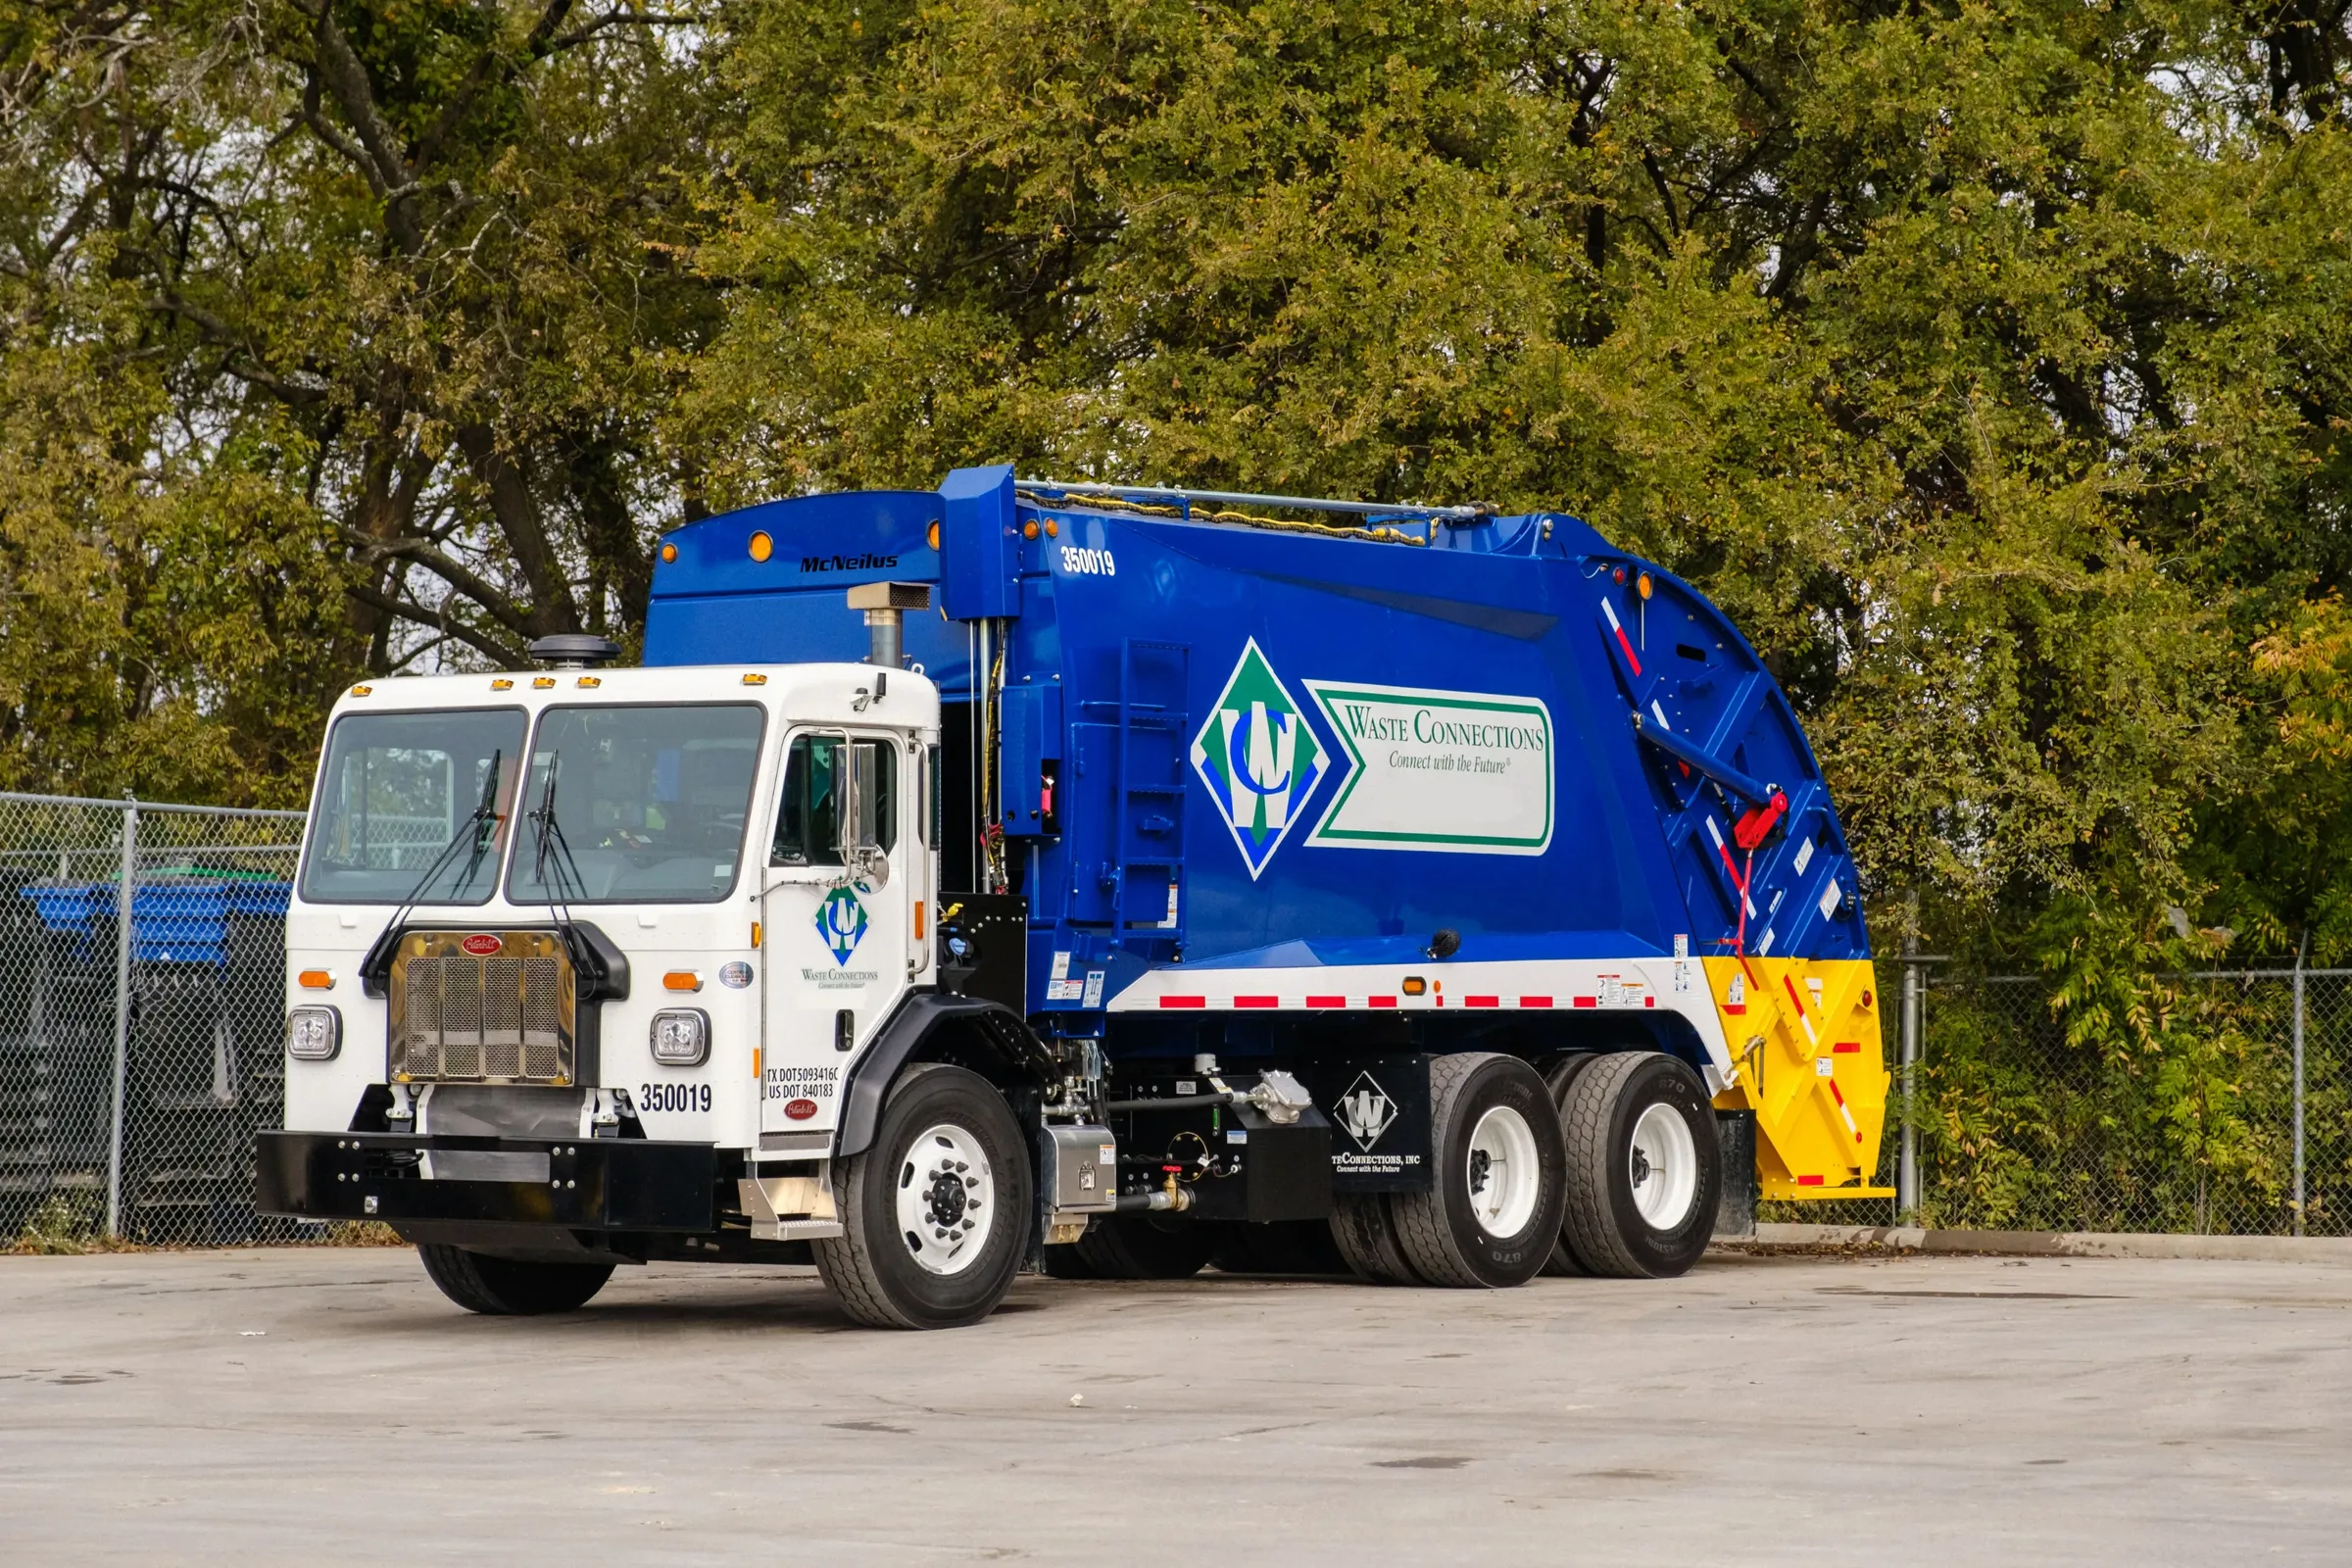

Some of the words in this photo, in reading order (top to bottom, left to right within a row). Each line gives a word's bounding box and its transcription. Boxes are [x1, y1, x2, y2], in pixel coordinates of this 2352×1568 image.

[800, 554, 899, 573] McNeilus
[1060, 546, 1115, 576] 350019
[1345, 705, 1408, 742] WASTE
[1414, 709, 1544, 752] CONNECTIONS
[1389, 750, 1431, 769] Connect
[1433, 754, 1454, 771] with
[1456, 754, 1472, 772] the
[802, 968, 827, 981] WASTE
[828, 968, 878, 981] CONNECTIONS
[767, 1068, 777, 1083] TX
[641, 1084, 711, 1112] 350019
[769, 1085, 781, 1099] US
[783, 1084, 800, 1099] DOT
[802, 1083, 833, 1098] 840183
[1405, 1155, 1420, 1164] INC
